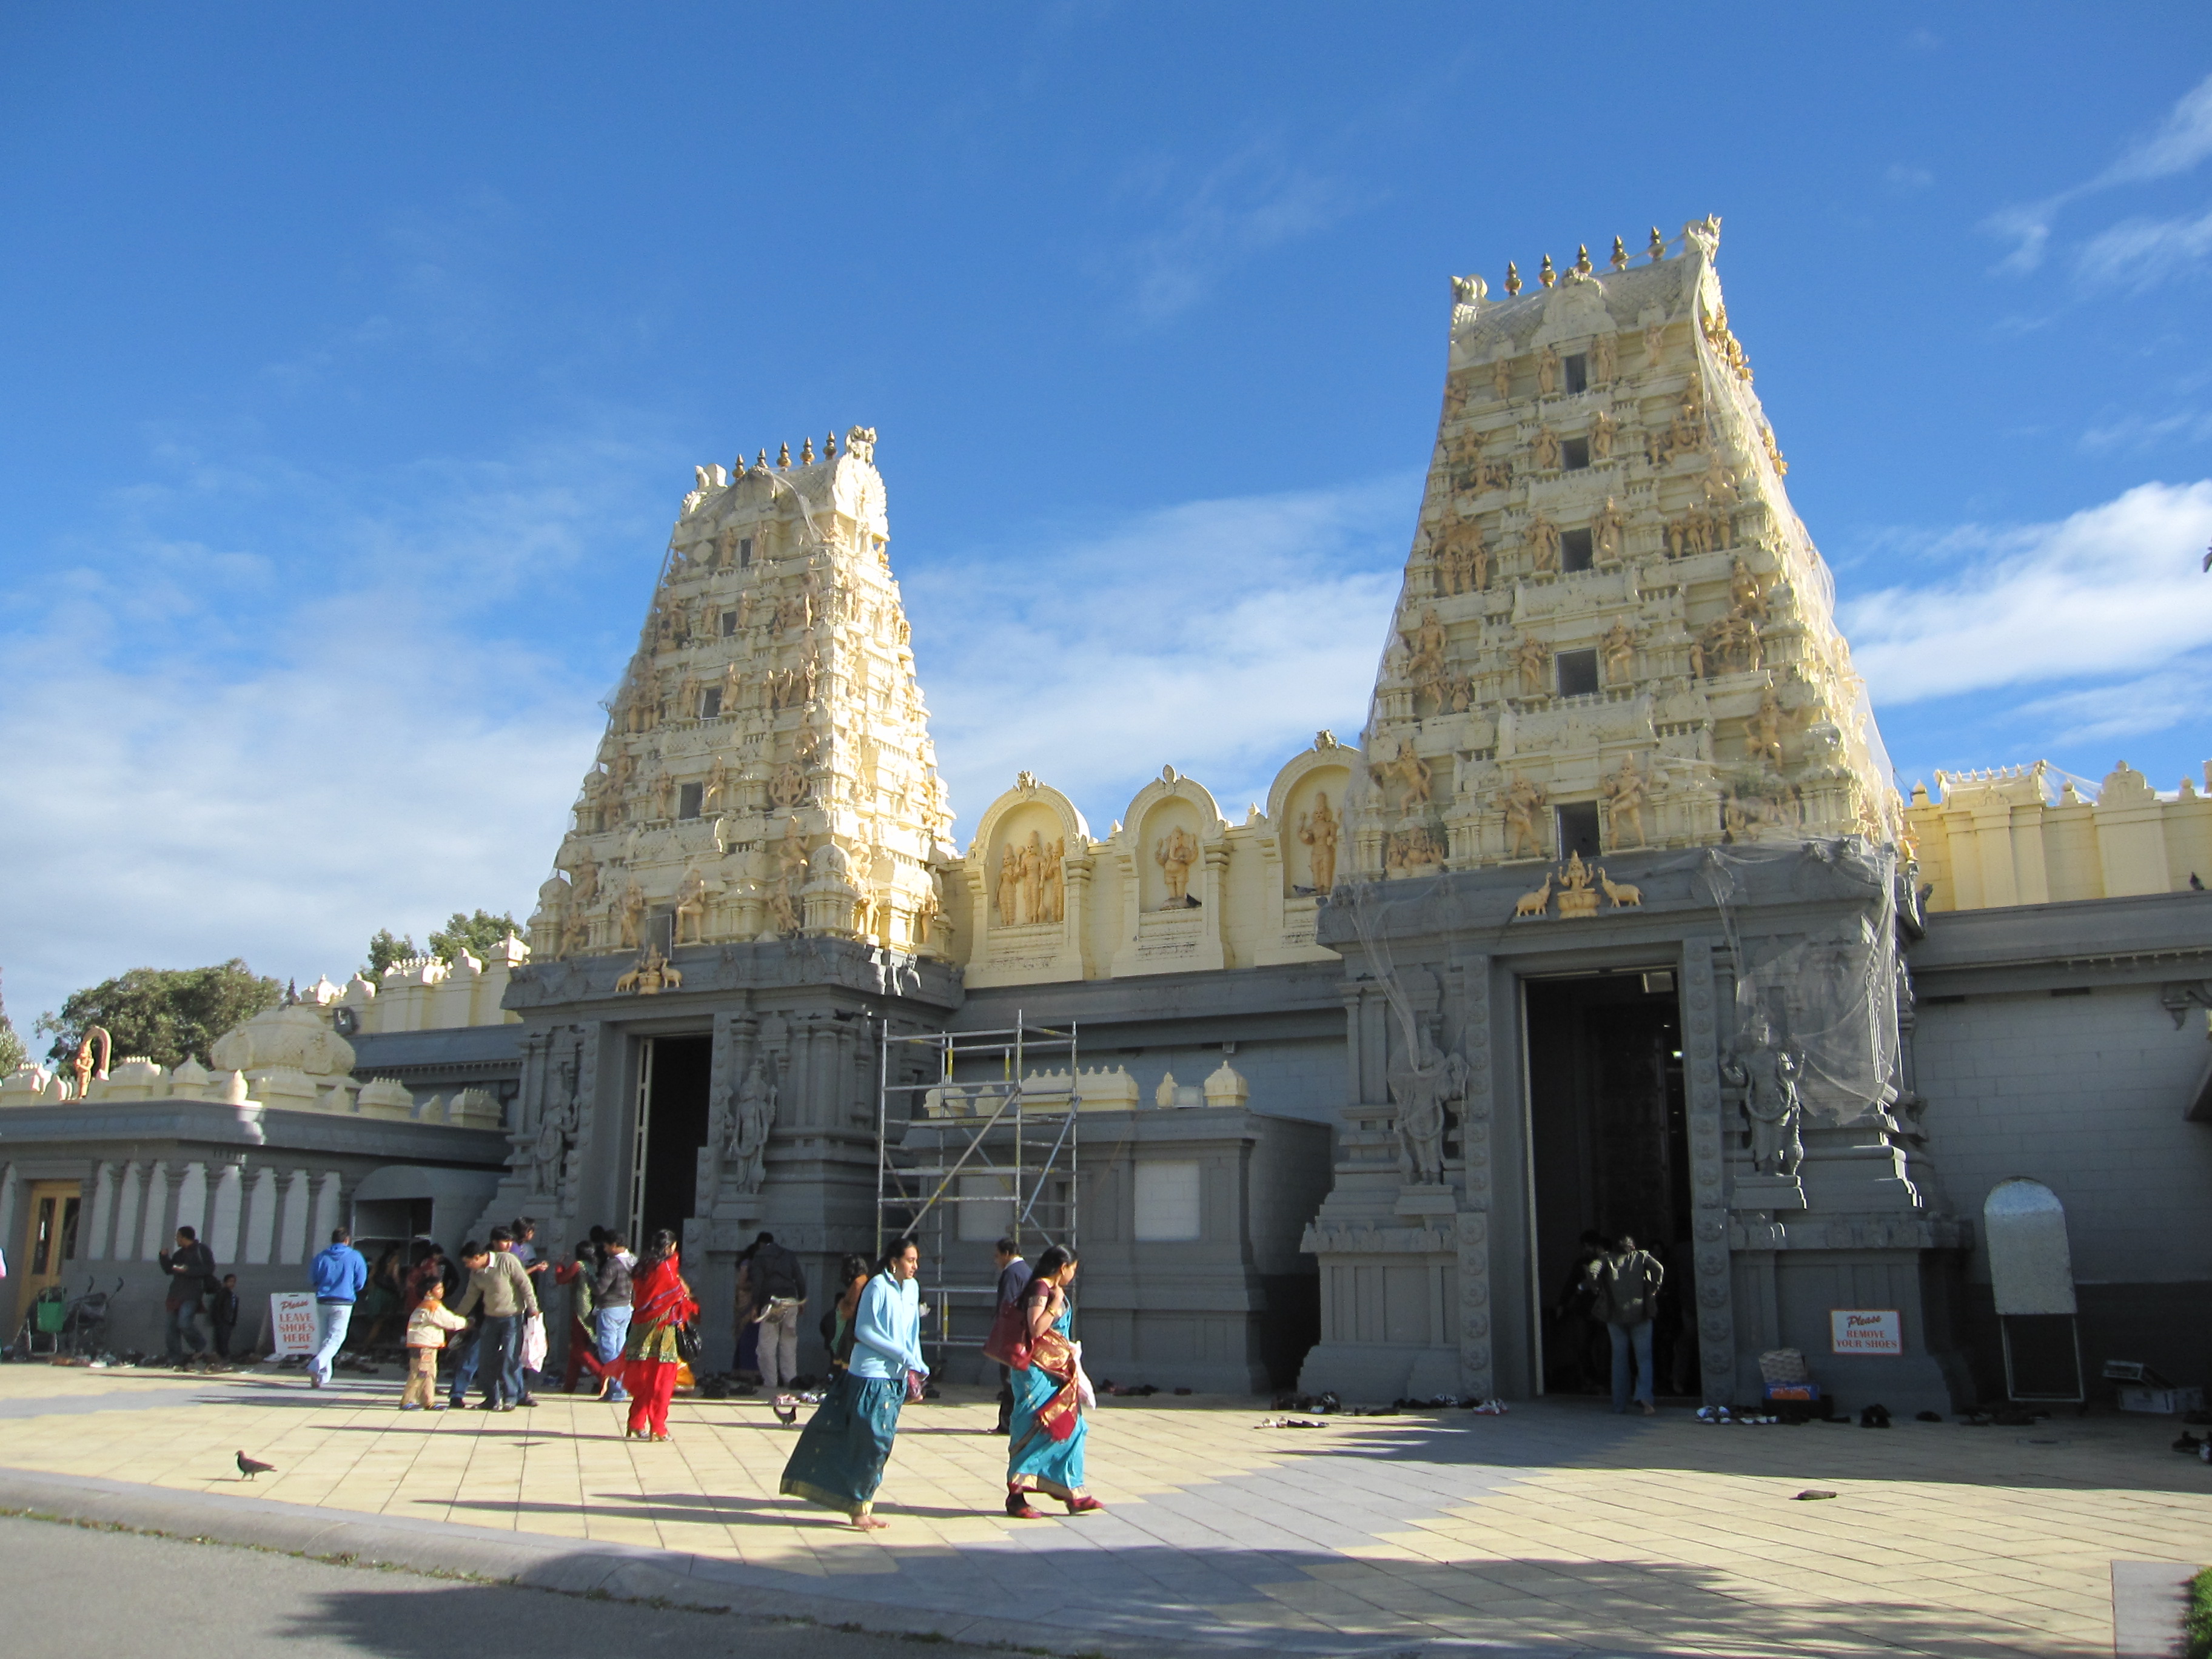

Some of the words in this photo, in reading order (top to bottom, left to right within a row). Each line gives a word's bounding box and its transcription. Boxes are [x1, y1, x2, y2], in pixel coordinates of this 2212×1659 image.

[280, 1299, 309, 1311] Please
[280, 1313, 313, 1322] LEAVE
[1847, 1315, 1882, 1328] Please
[279, 1323, 315, 1332] SHOES
[284, 1333, 313, 1342] HERE
